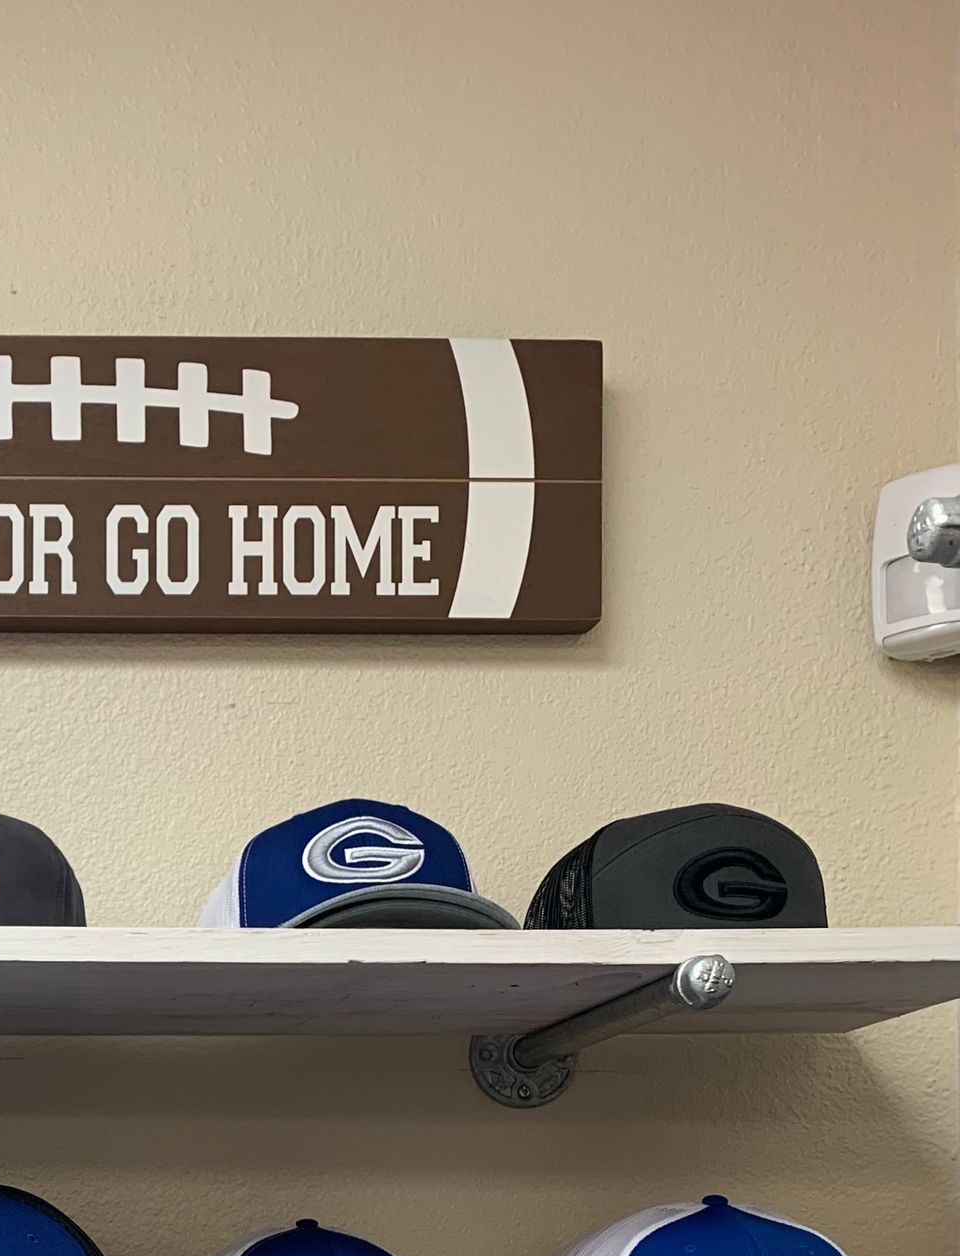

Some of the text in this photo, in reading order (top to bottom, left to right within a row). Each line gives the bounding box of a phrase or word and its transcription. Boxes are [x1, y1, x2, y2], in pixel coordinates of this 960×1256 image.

[106, 504, 200, 595] GO
[228, 505, 440, 596] HOME
[302, 816, 425, 884] G
[673, 846, 788, 921] G
